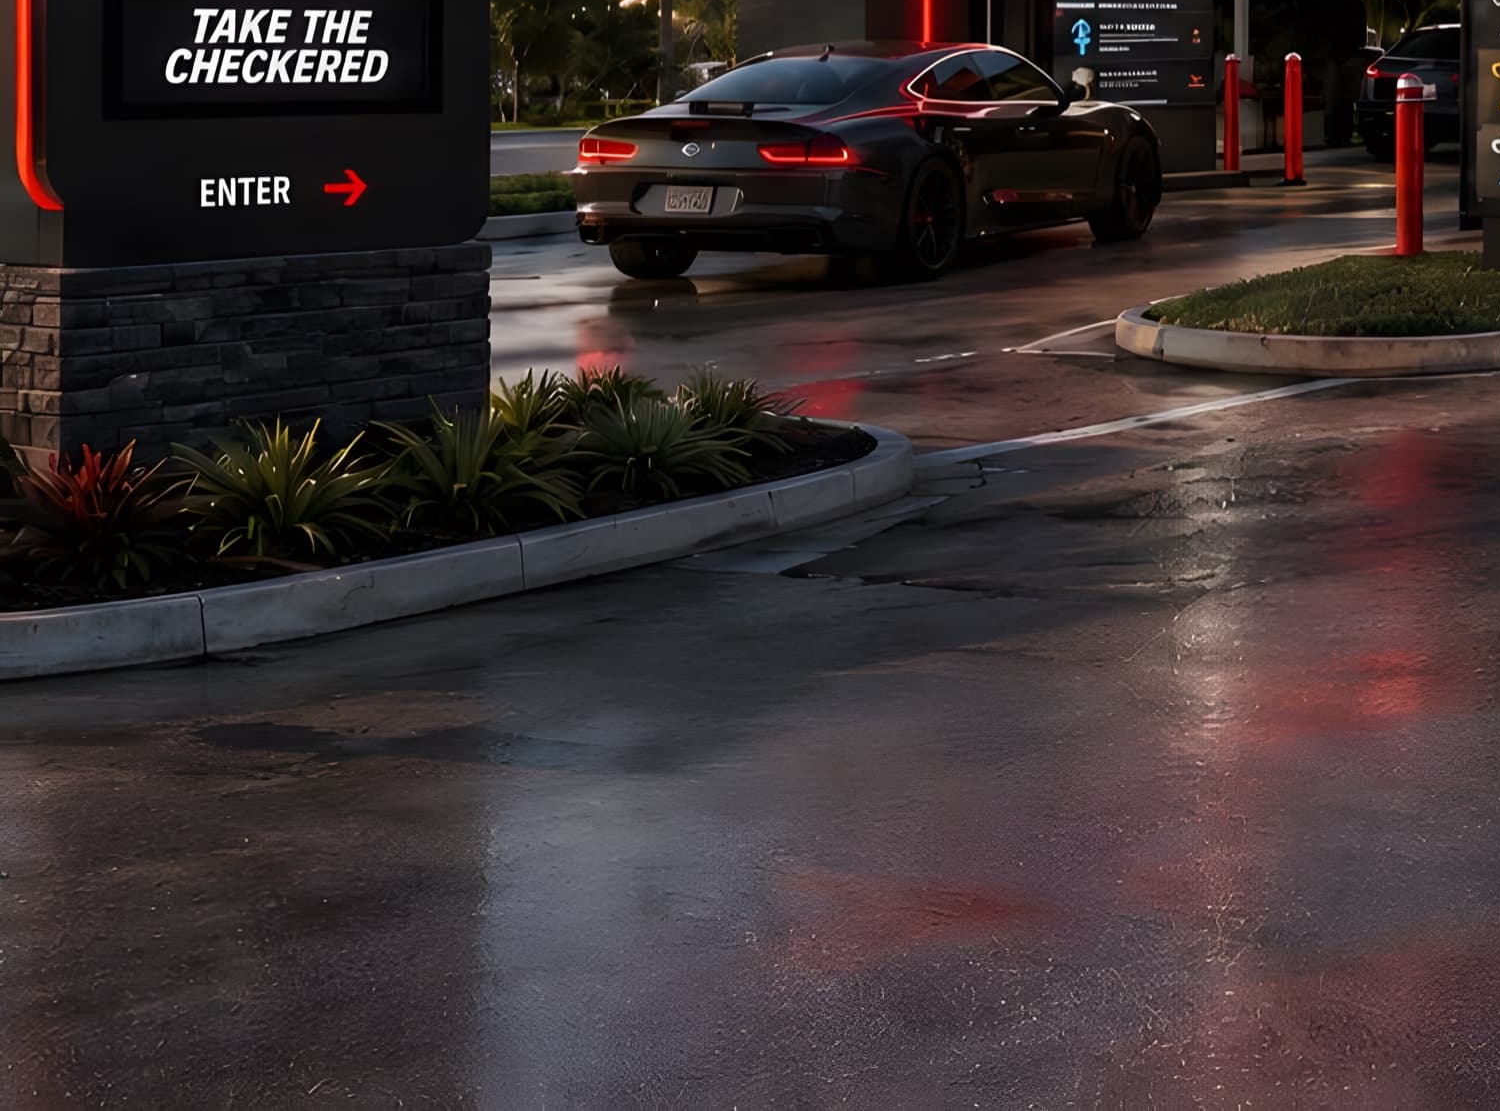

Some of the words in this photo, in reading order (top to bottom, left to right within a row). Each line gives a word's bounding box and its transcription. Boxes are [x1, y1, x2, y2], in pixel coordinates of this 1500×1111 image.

[192, 7, 293, 45] TAKE
[302, 8, 374, 45] THE
[164, 47, 390, 85] CHECKERED
[199, 175, 291, 209] ENTER
